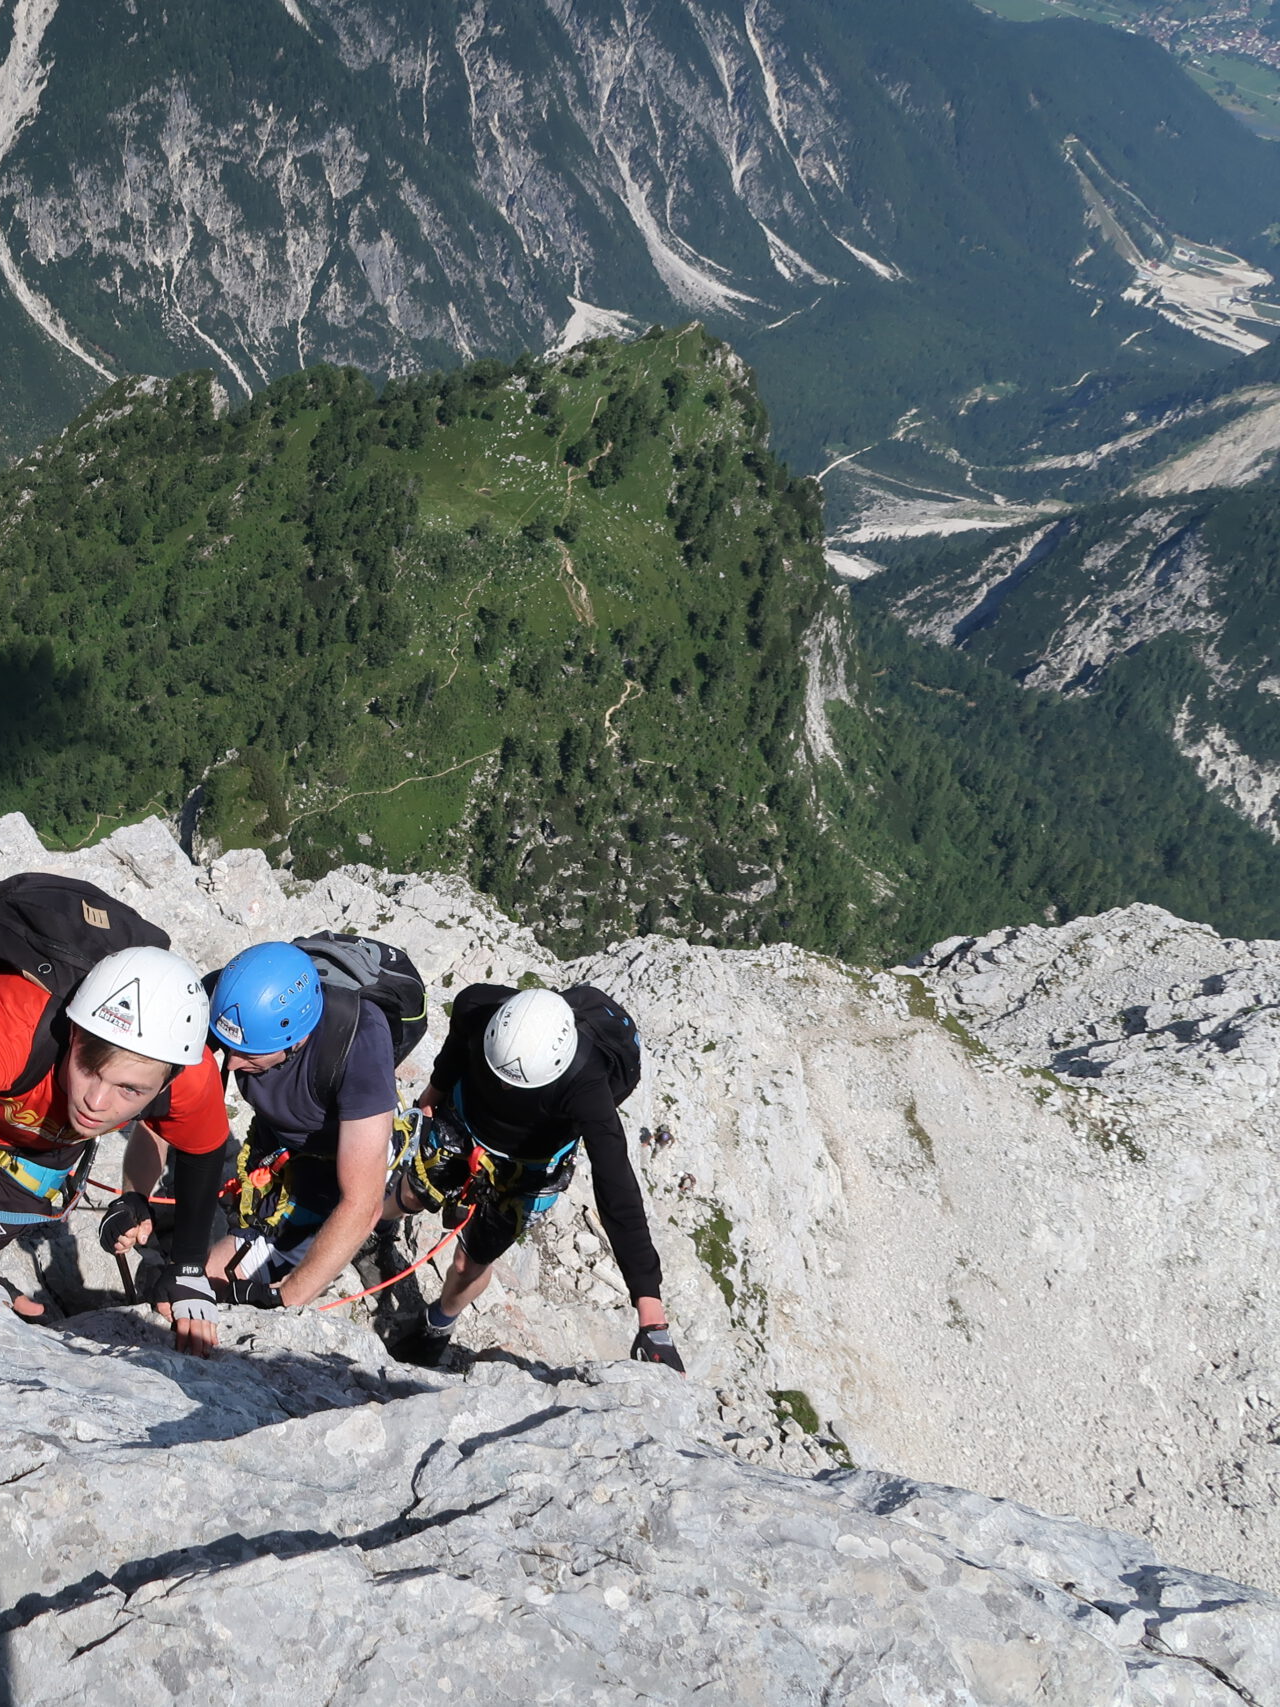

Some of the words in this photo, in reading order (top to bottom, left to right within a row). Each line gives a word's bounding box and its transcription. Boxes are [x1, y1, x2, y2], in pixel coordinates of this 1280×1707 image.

[278, 972, 311, 1007] CAMP
[551, 1019, 570, 1051] CAMP
[181, 1265, 200, 1275] FITJO
